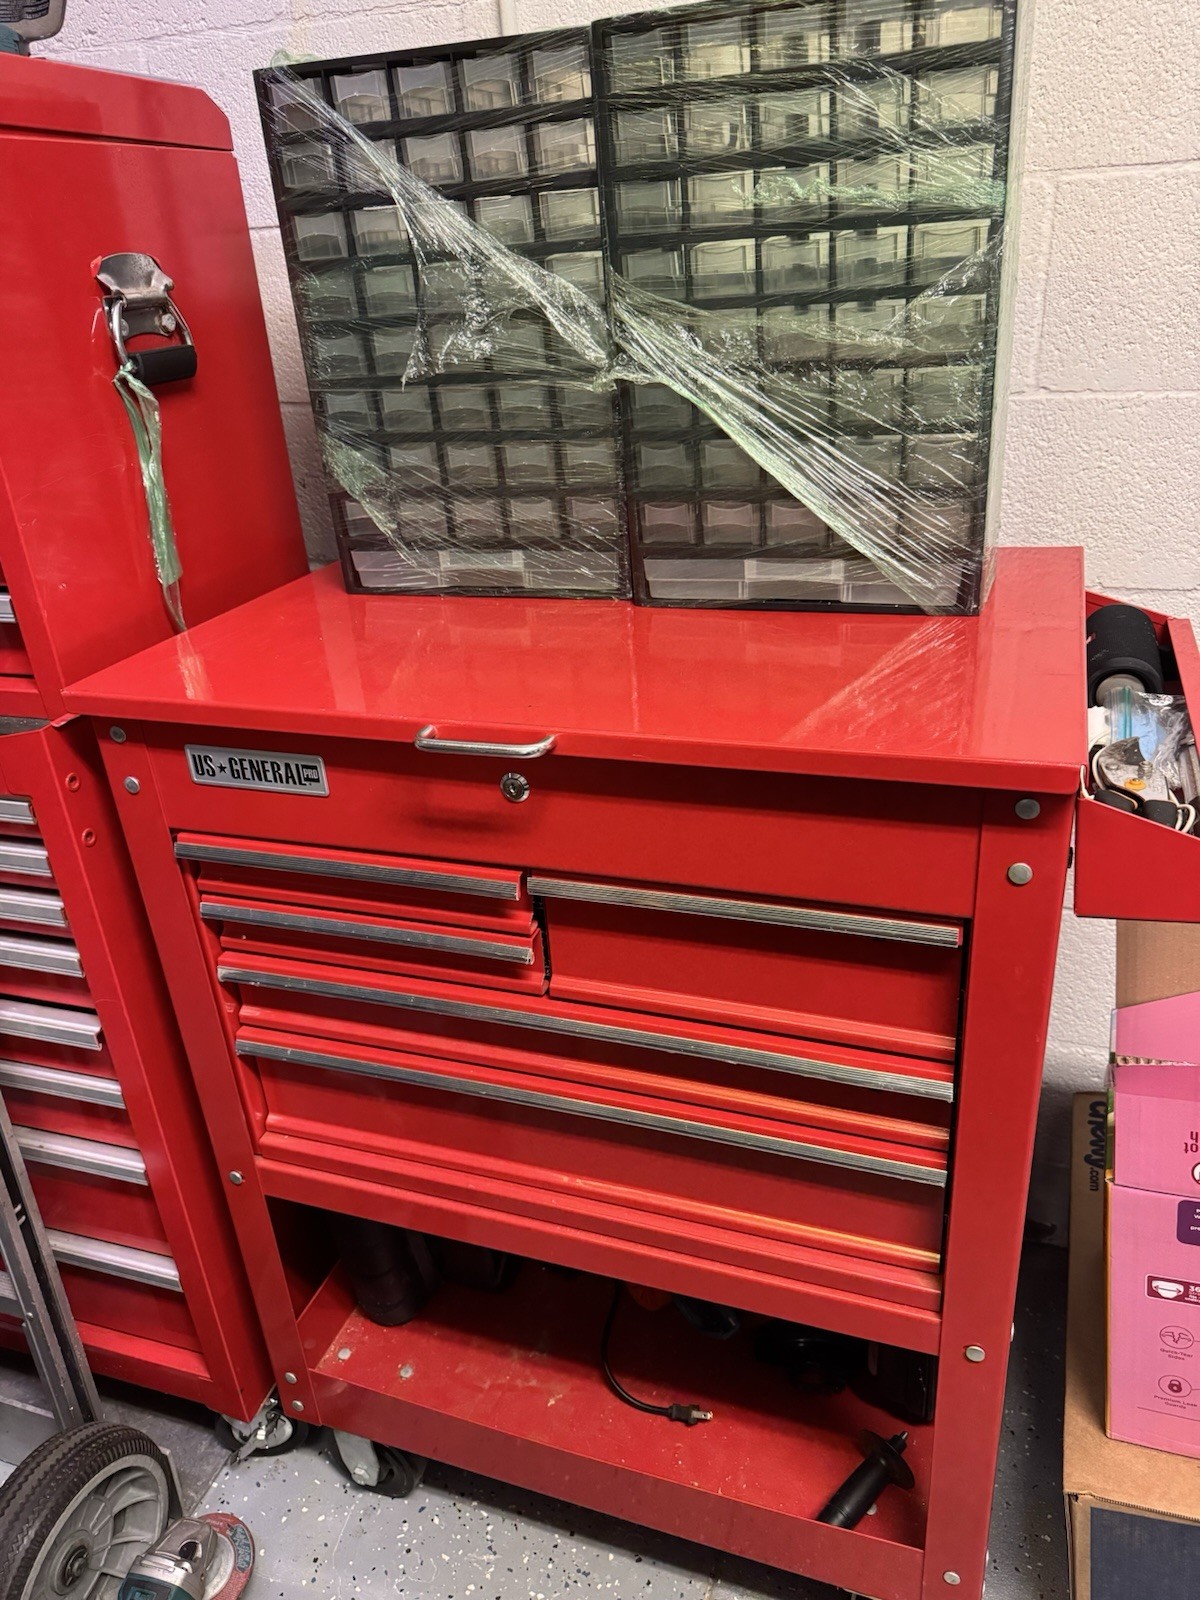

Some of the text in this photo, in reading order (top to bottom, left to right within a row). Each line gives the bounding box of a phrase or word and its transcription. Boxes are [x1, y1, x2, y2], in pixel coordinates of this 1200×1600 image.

[192, 754, 319, 786] US GENERAL PRO
